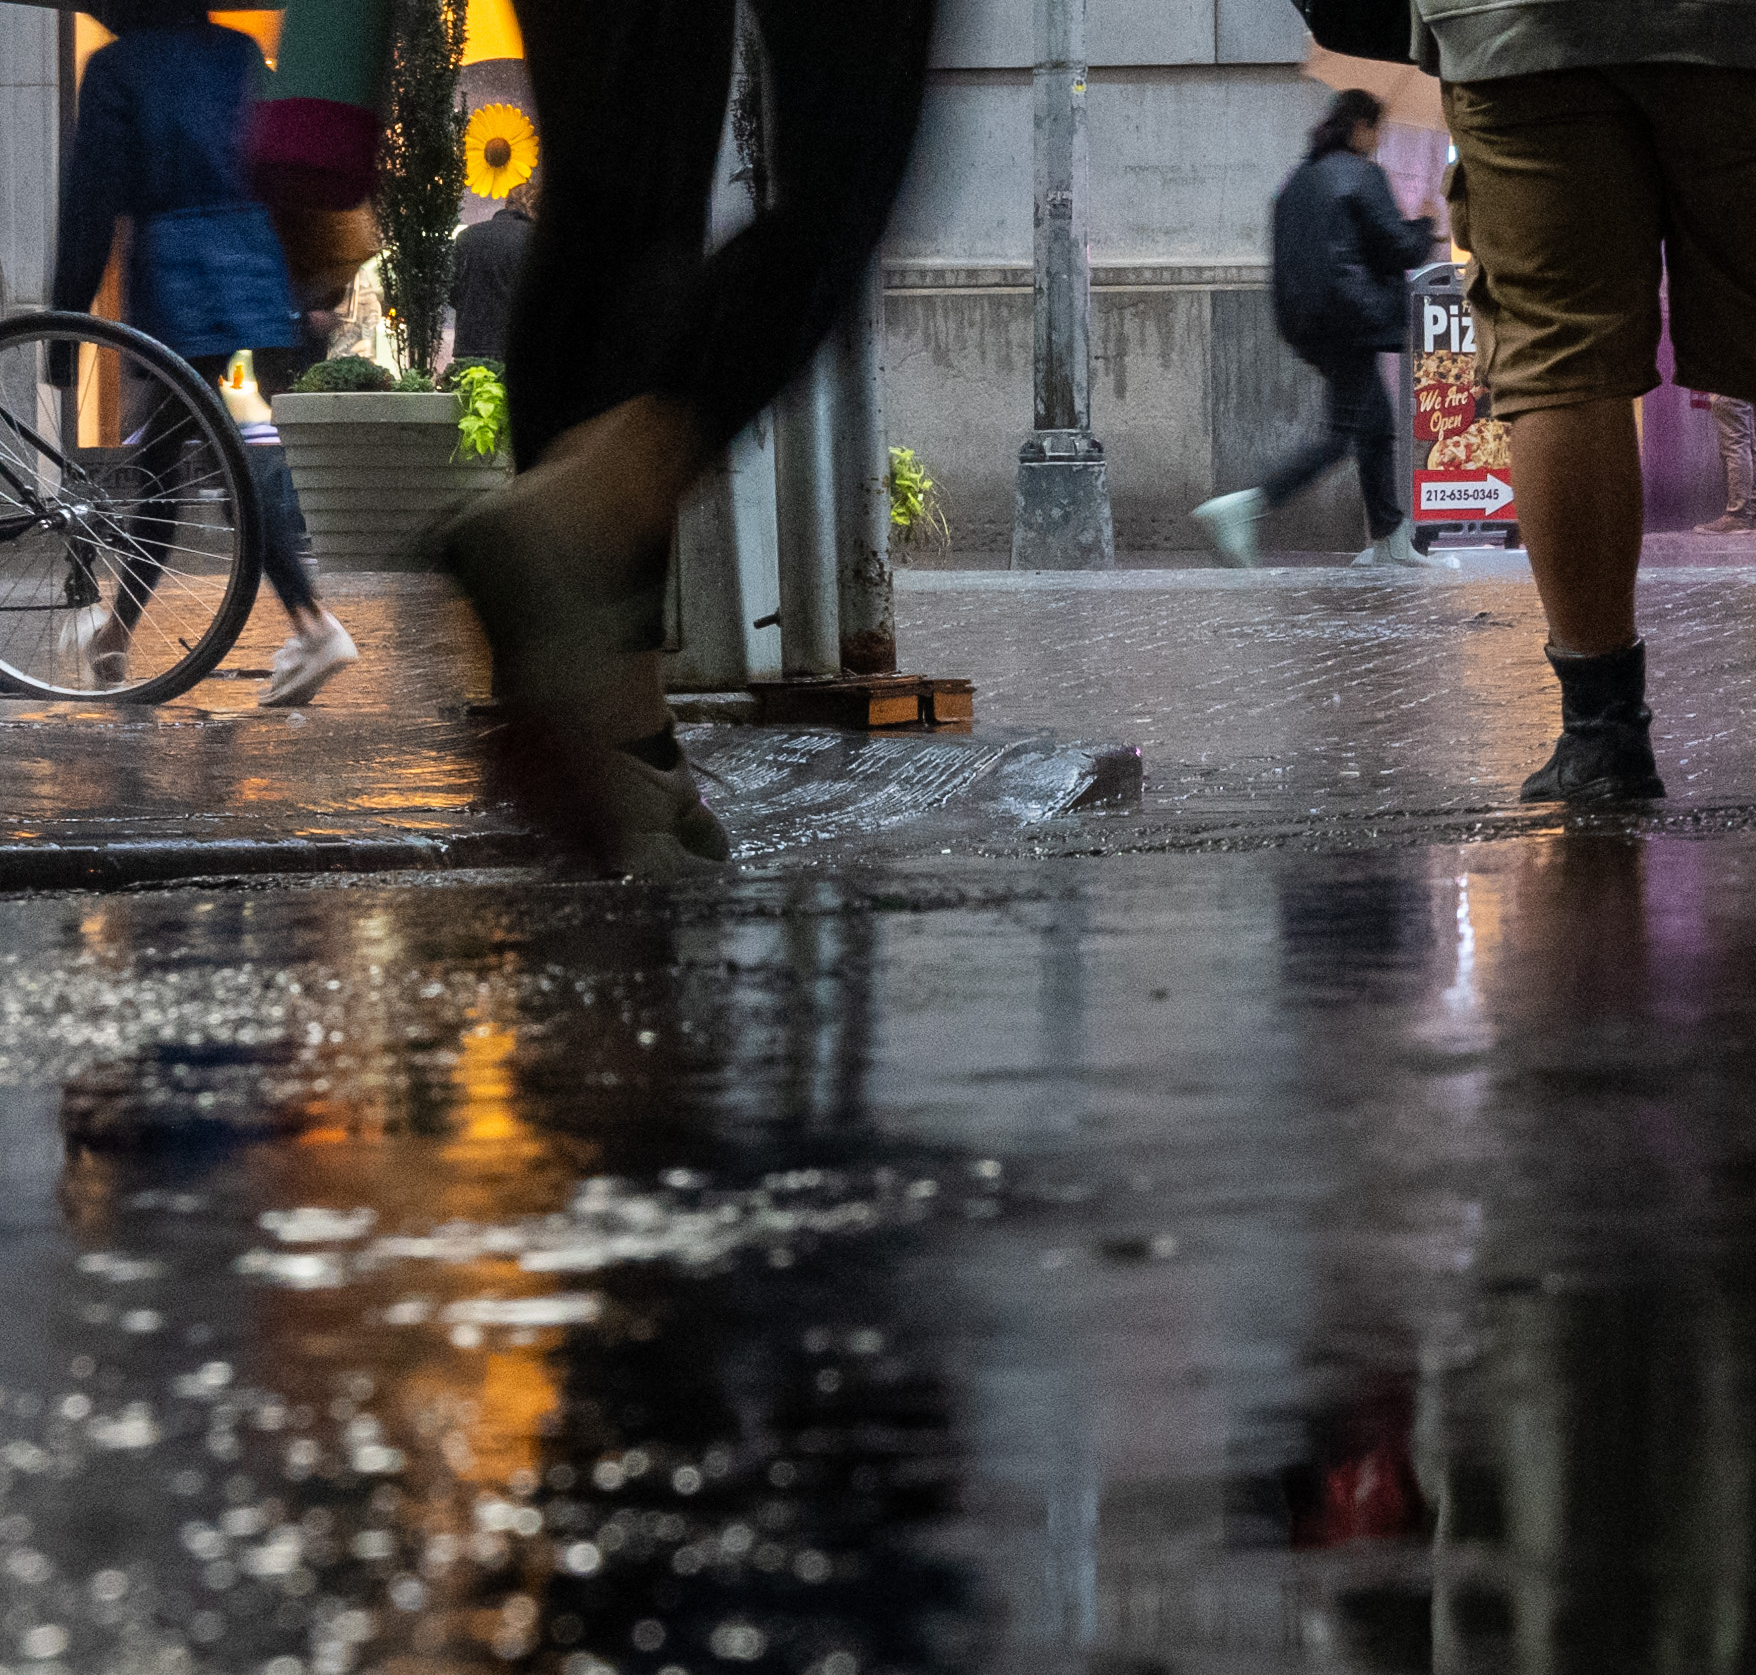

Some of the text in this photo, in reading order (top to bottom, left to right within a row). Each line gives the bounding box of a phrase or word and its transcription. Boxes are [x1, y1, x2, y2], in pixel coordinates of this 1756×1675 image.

[1424, 305, 1476, 353] Piz
[1419, 387, 1468, 412] We Are
[1430, 411, 1462, 440] Open
[1426, 488, 1500, 502] 212-635-0345
